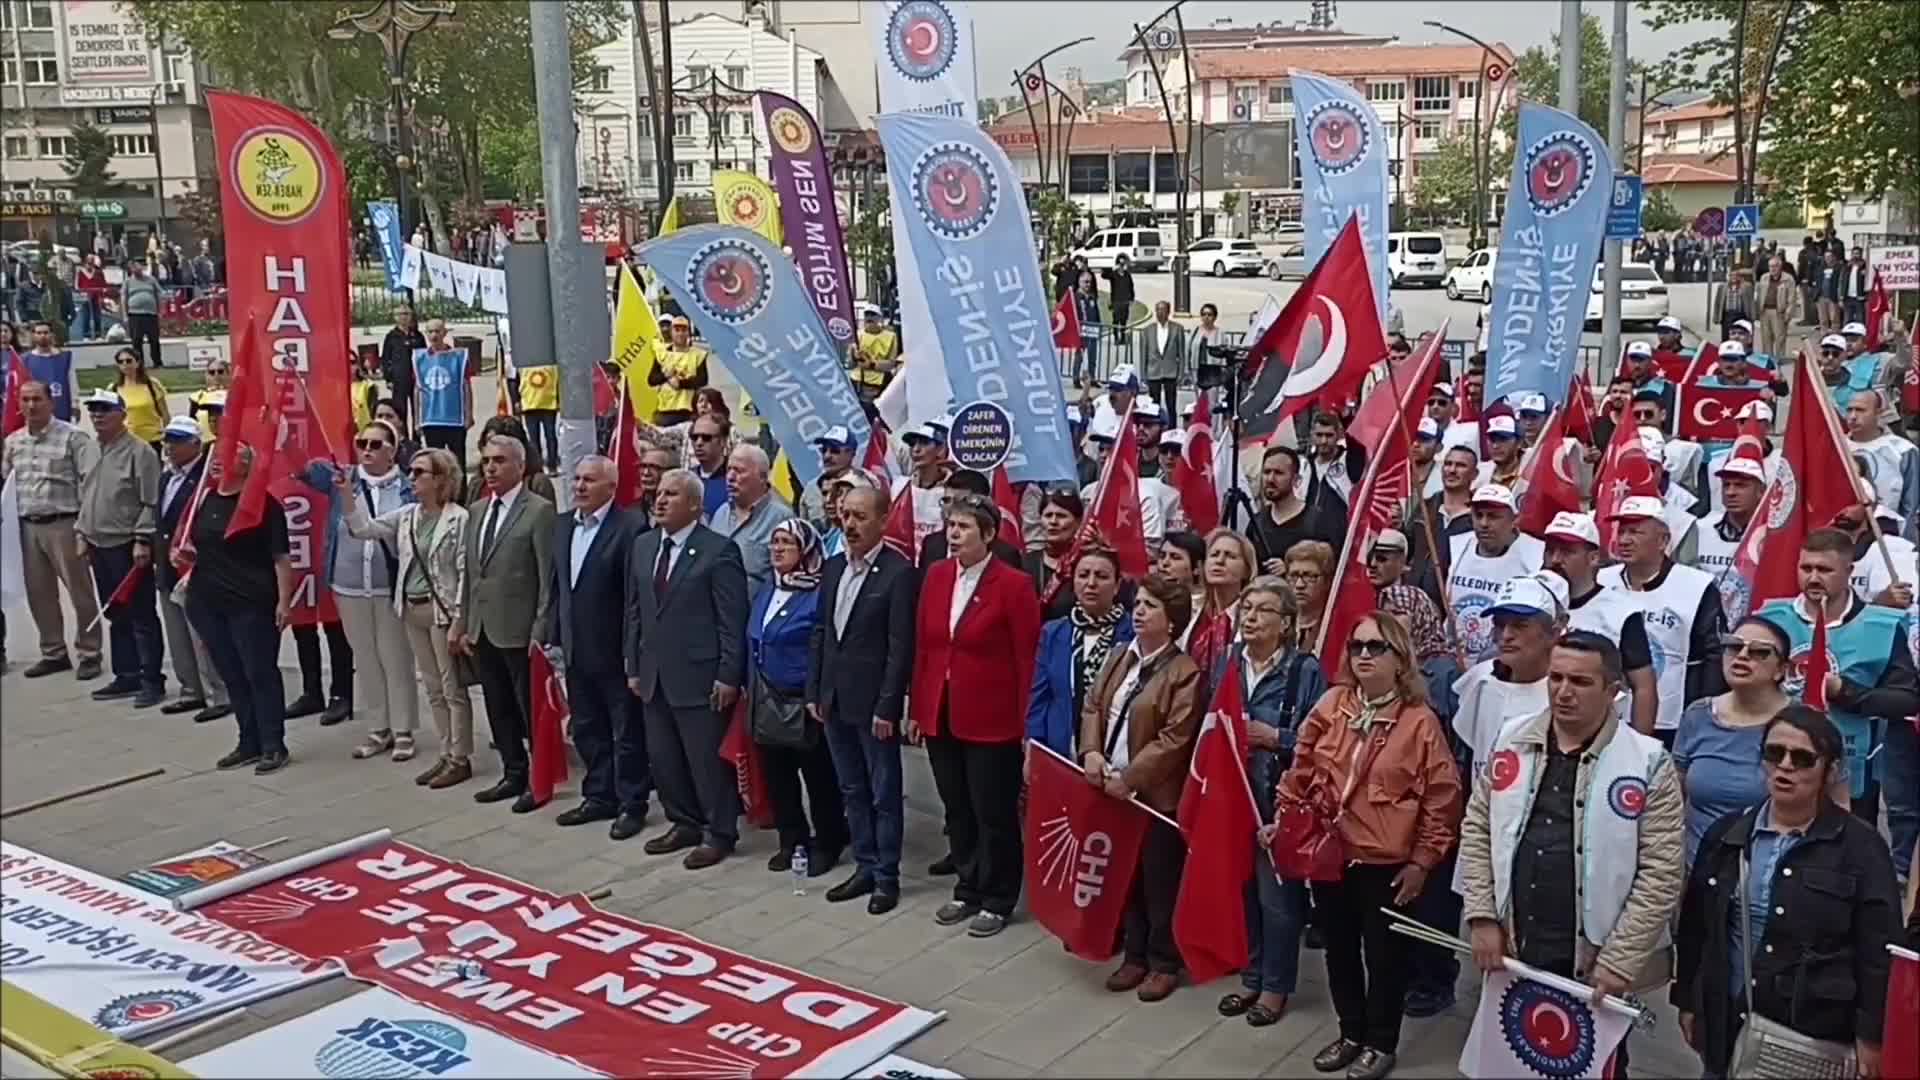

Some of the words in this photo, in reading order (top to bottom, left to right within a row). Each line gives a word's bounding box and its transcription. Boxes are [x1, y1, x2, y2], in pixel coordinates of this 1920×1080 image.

[81, 24, 119, 35] TEMMUZ
[128, 39, 140, 51] VE
[1885, 250, 1914, 259] EMEK
[967, 410, 996, 421] ZAFER
[962, 423, 1002, 434] DİRENEN
[955, 437, 1006, 449] EMEKÇİNİN
[962, 452, 998, 462] OLACAK
[1452, 575, 1502, 593] ELEDİYE
[285, 876, 360, 902] CHP
[355, 848, 881, 1031] DEĞERDİR
[359, 899, 563, 980] YÜCE
[373, 934, 585, 1031] EMEK
[574, 971, 712, 1025] EN
[336, 1017, 472, 1076] KESK
[706, 1021, 802, 1059] CHP
